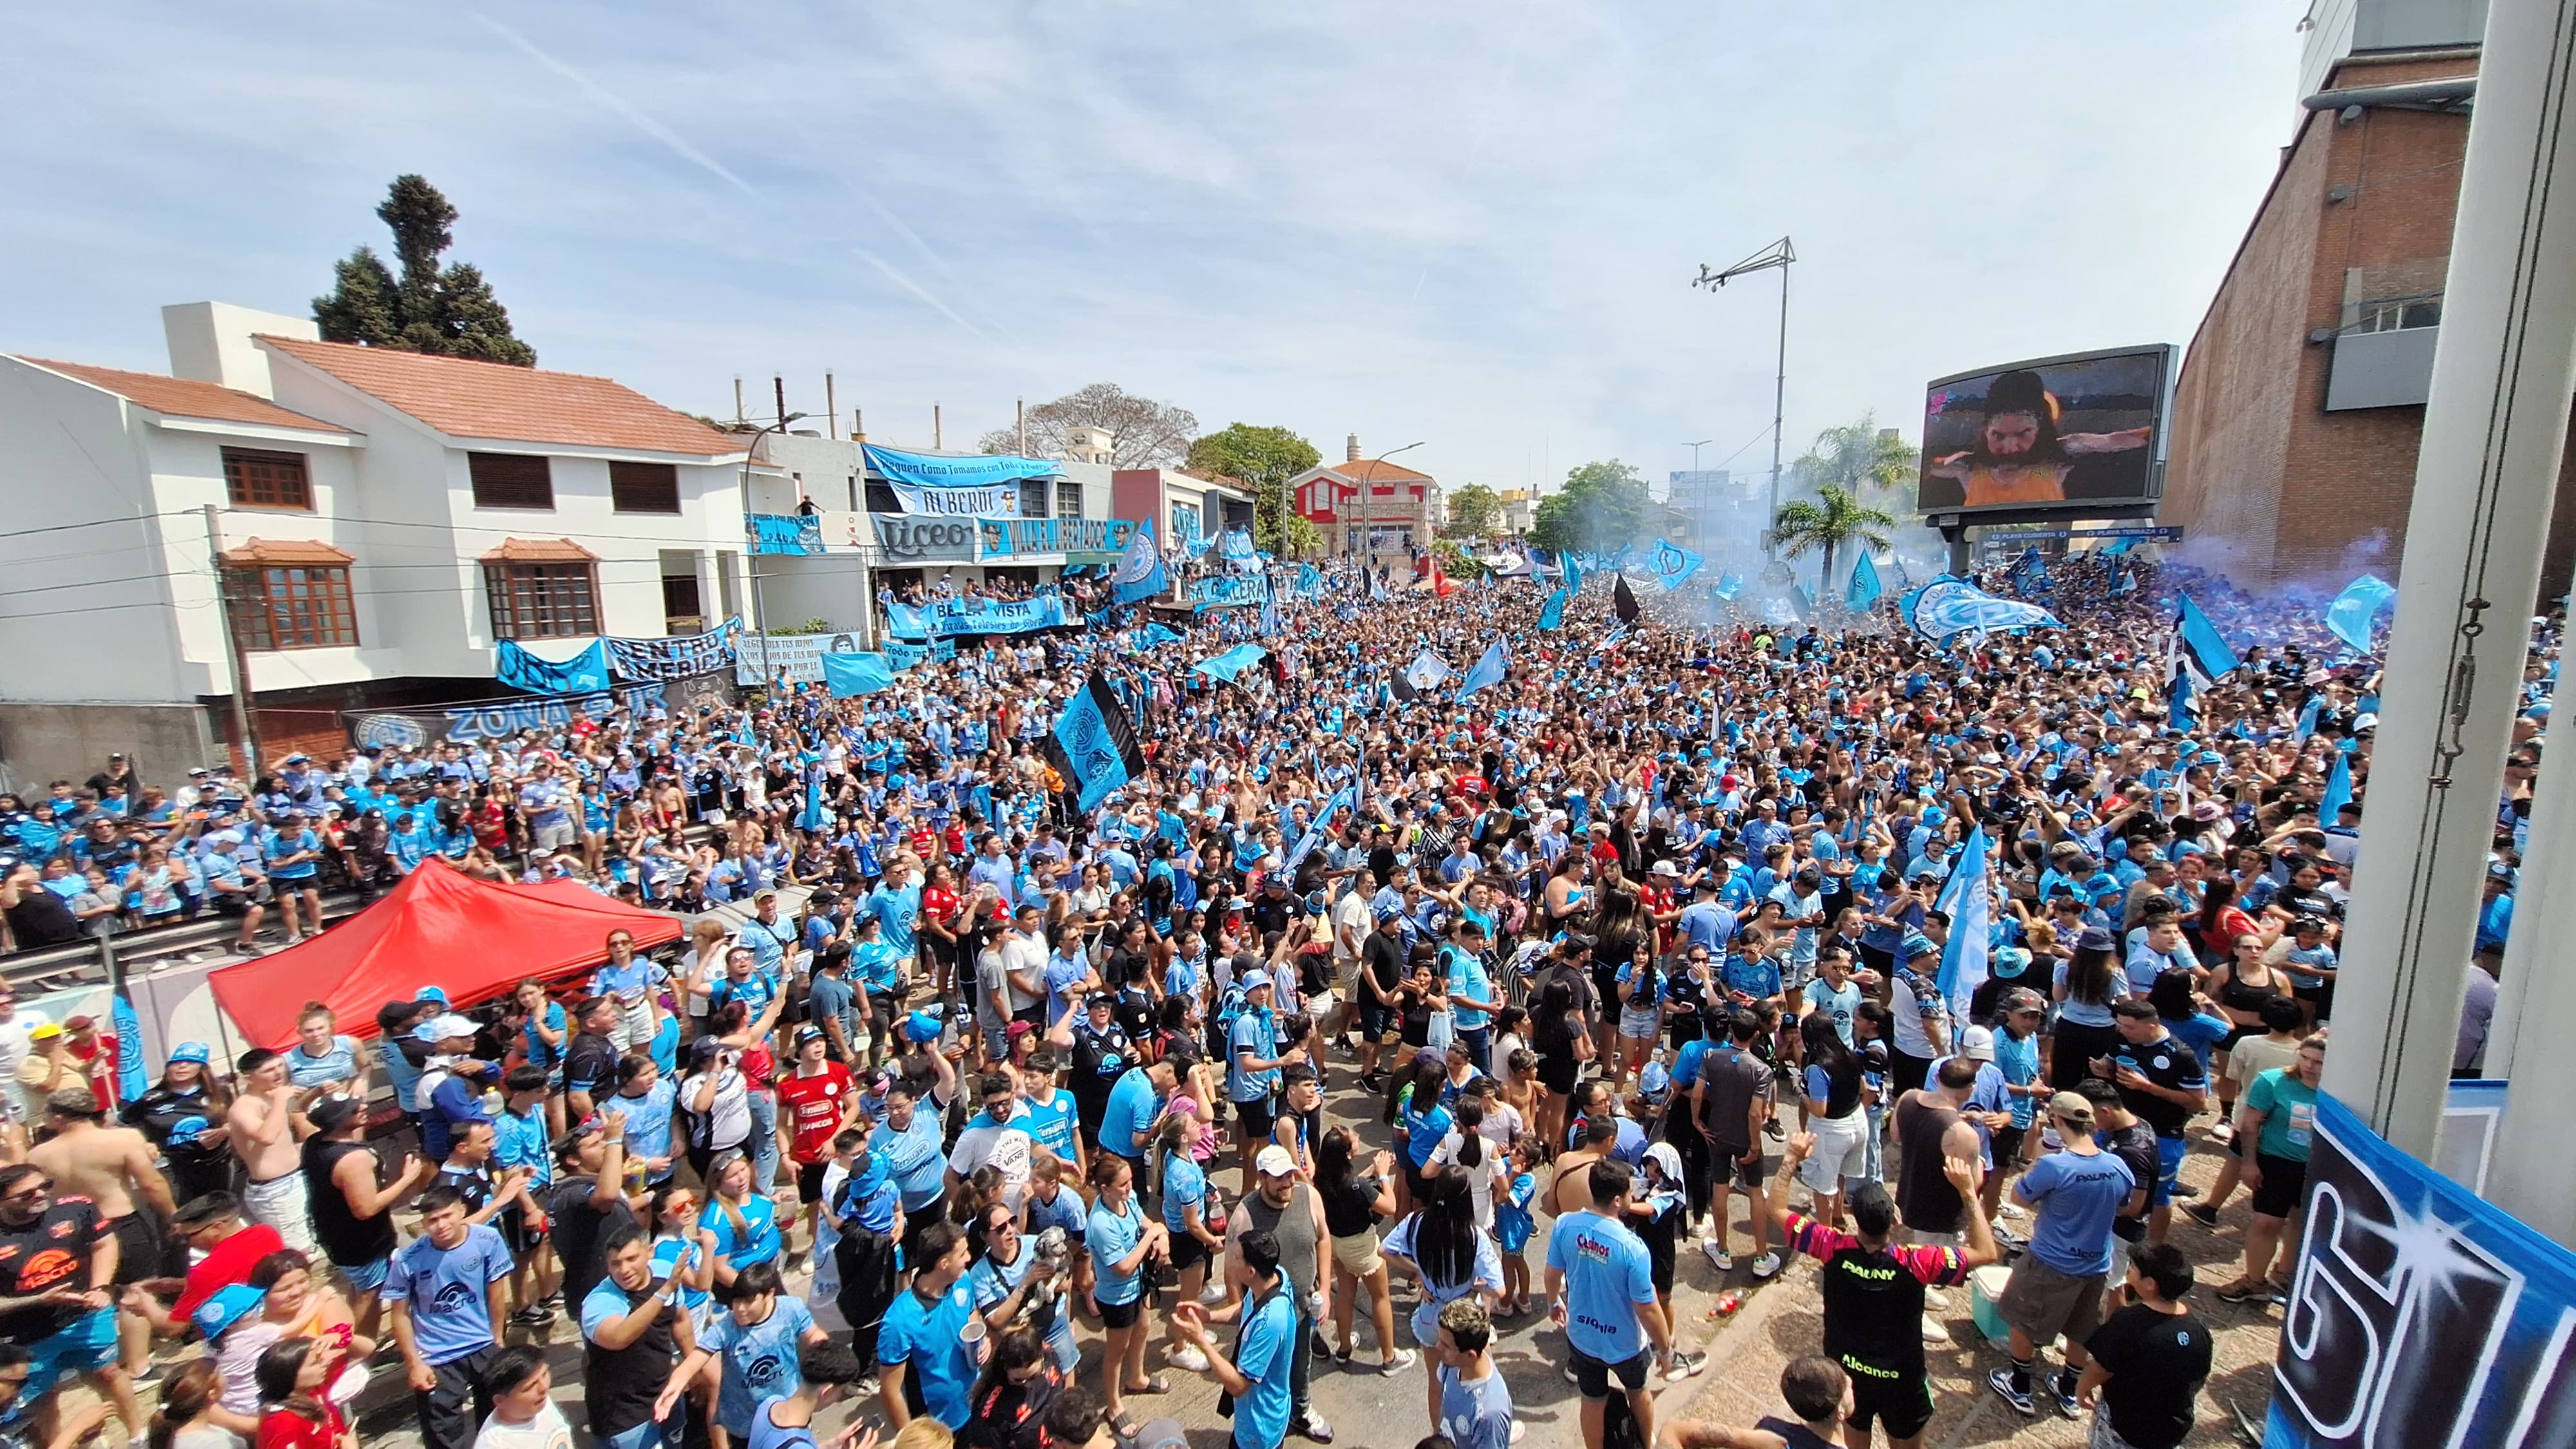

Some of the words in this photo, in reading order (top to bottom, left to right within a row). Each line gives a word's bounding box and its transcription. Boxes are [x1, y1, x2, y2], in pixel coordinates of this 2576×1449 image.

[922, 463, 946, 475] Como
[947, 464, 986, 475] Tomamos
[923, 491, 994, 514] ALBERDI
[1008, 520, 1036, 553] VILLA
[1053, 519, 1106, 552] LIBERTADOR
[994, 603, 1031, 617] VISTA
[782, 639, 793, 648] TUS
[795, 638, 814, 648] HIJOS
[747, 651, 759, 660] LOS
[761, 651, 782, 661] HJOS
[782, 650, 792, 660] DE
[794, 650, 806, 659] TUS
[793, 663, 806, 671] POR
[810, 661, 819, 670] EL
[167, 1132, 198, 1147] Mac
[1001, 1139, 1012, 1149] THE
[893, 1144, 928, 1170] Tersuave
[1004, 1148, 1025, 1167] VANS
[2075, 1171, 2117, 1182] PAUNY
[1577, 1233, 1609, 1258] Casinos
[1842, 1260, 1896, 1280] PAUNY
[430, 1293, 477, 1314] Macro
